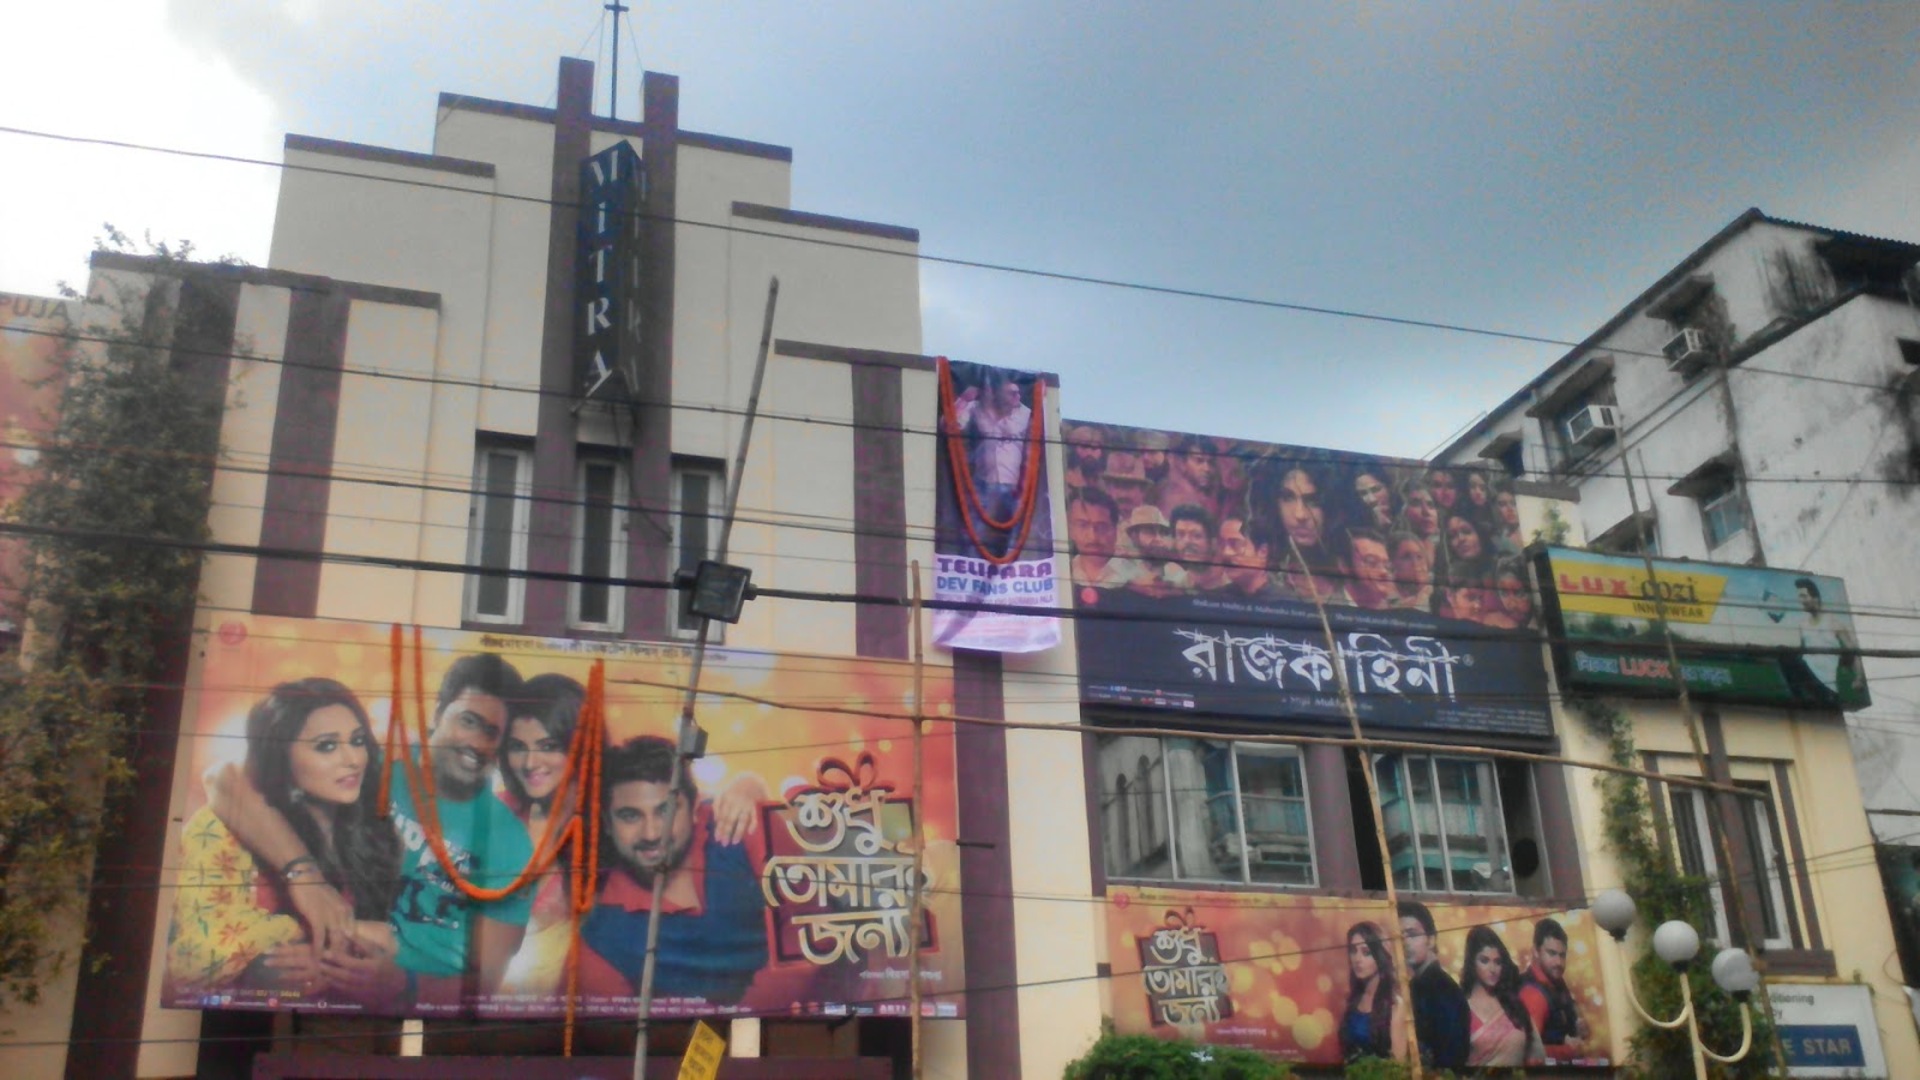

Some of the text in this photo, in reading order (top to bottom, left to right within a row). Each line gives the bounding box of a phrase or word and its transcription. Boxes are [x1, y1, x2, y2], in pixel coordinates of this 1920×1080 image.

[936, 575, 968, 590] DEV
[1012, 577, 1054, 594] CLUB
[1559, 573, 1632, 597] LUX
[1633, 601, 1704, 618] INNRWEAR
[1619, 656, 1673, 680] LUCK
[1803, 1037, 1852, 1056] STAR
